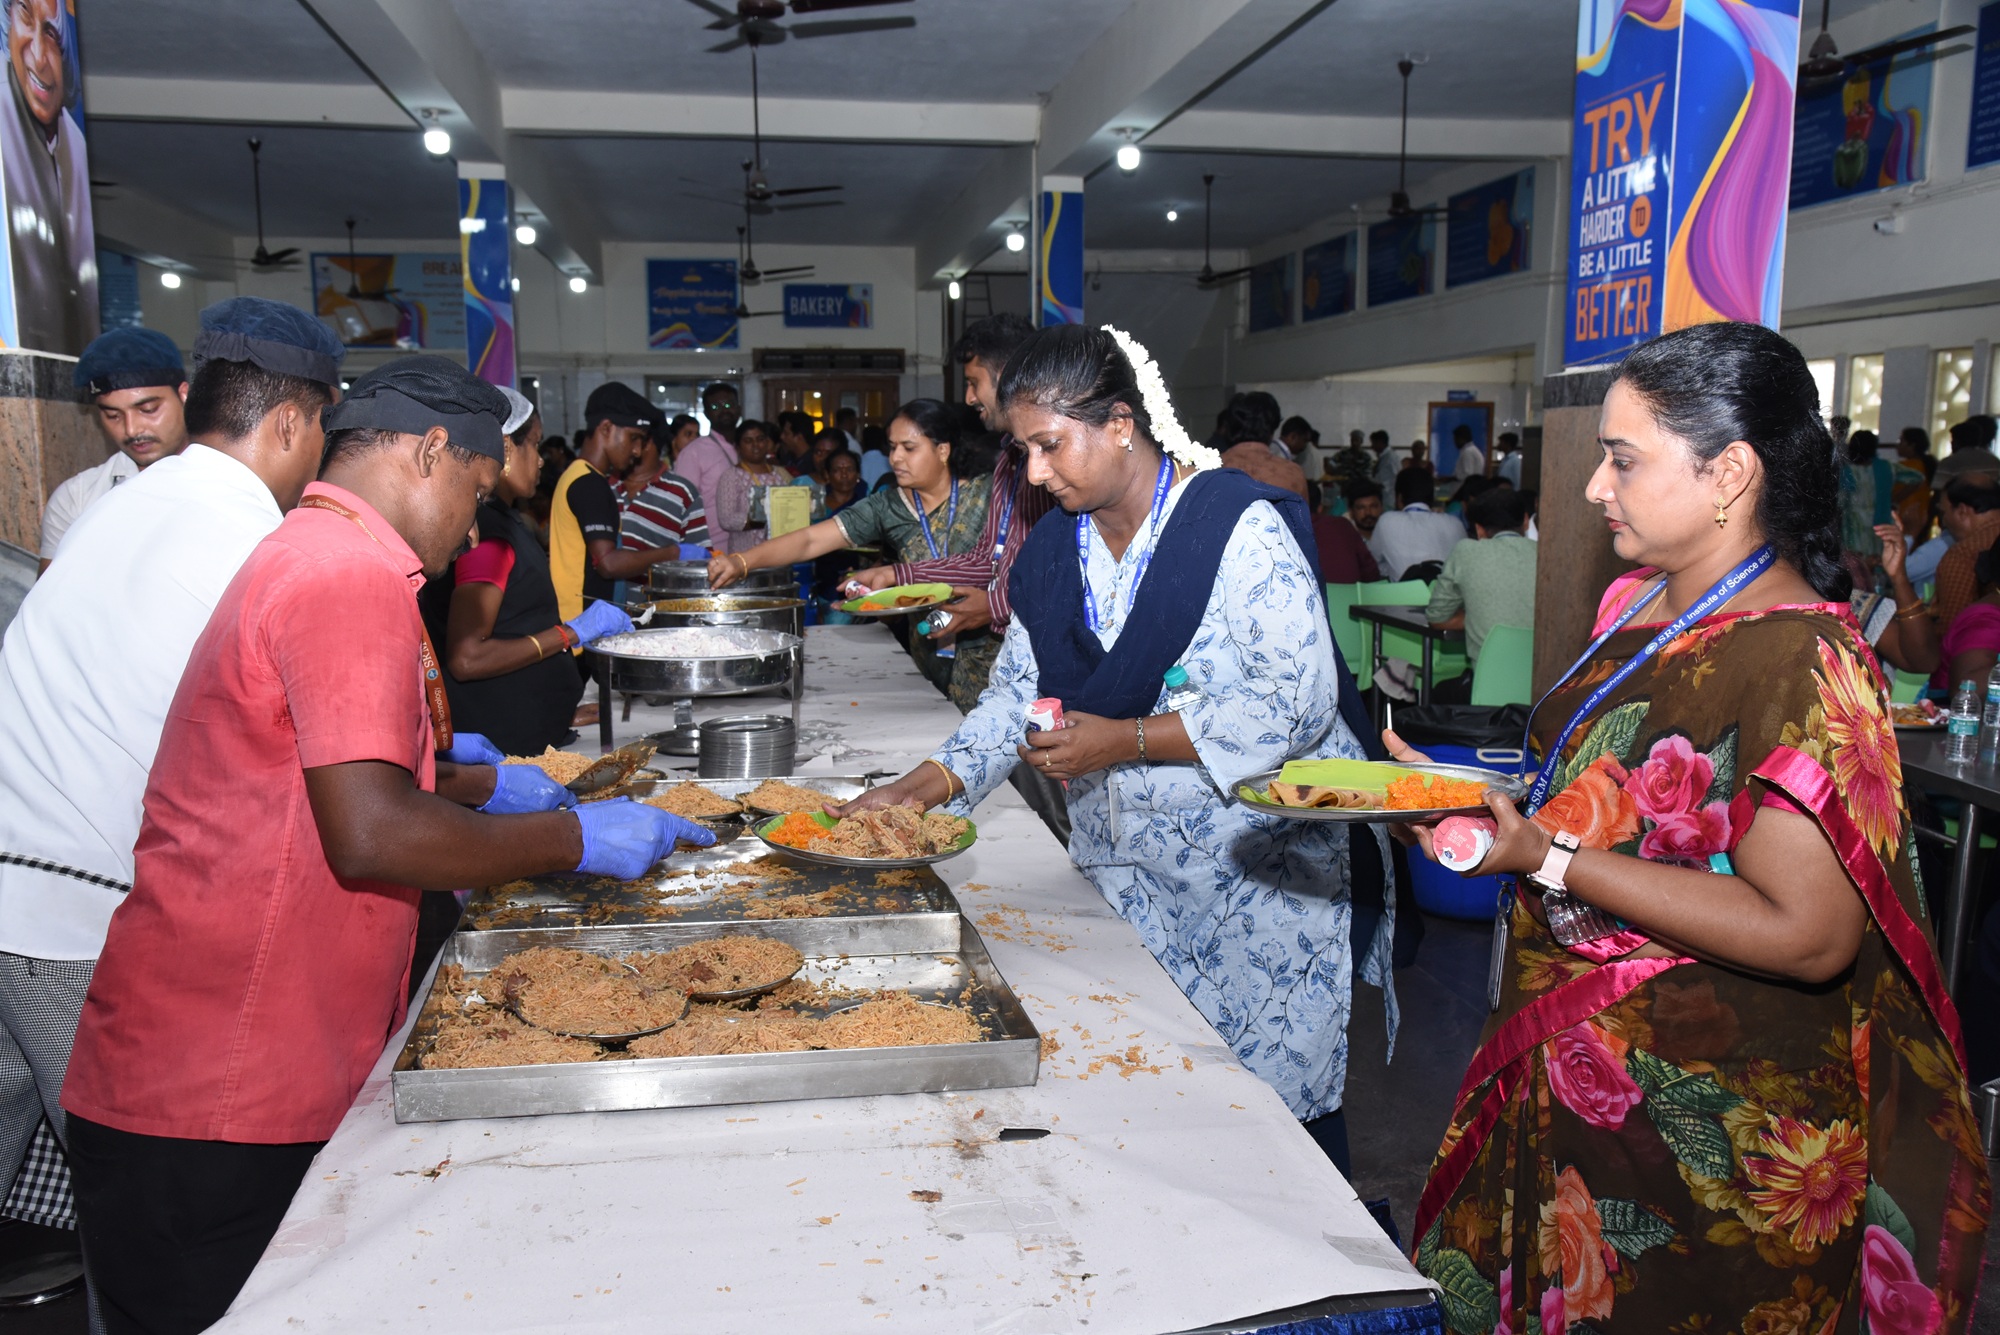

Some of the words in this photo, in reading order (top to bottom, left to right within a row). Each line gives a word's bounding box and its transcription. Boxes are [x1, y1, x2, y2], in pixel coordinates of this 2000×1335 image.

[1583, 82, 1665, 173] TRY
[1581, 175, 1594, 210] A
[1579, 204, 1625, 248] HARDER
[1635, 206, 1646, 228] TO
[1579, 252, 1595, 278] BE
[1596, 250, 1606, 273] A
[1608, 239, 1652, 272] LITTLE
[790, 296, 844, 317] BAKERY
[1575, 275, 1652, 342] BETTER
[1159, 465, 1170, 489] Science
[1079, 527, 1088, 547] SRM
[1085, 606, 1096, 631] Science
[1608, 609, 1634, 633] SRM
[1634, 584, 1662, 608] Institute
[1657, 619, 1686, 645] SRM
[1687, 593, 1718, 621] Institute
[1718, 583, 1728, 596] of
[1726, 561, 1759, 589] Science
[1758, 551, 1771, 565] and
[1531, 775, 1549, 806] SRM
[1544, 746, 1560, 777] Institute
[1558, 737, 1564, 747] of
[1563, 709, 1585, 738] Science
[1584, 694, 1598, 710] and
[1597, 659, 1638, 695] Technology
